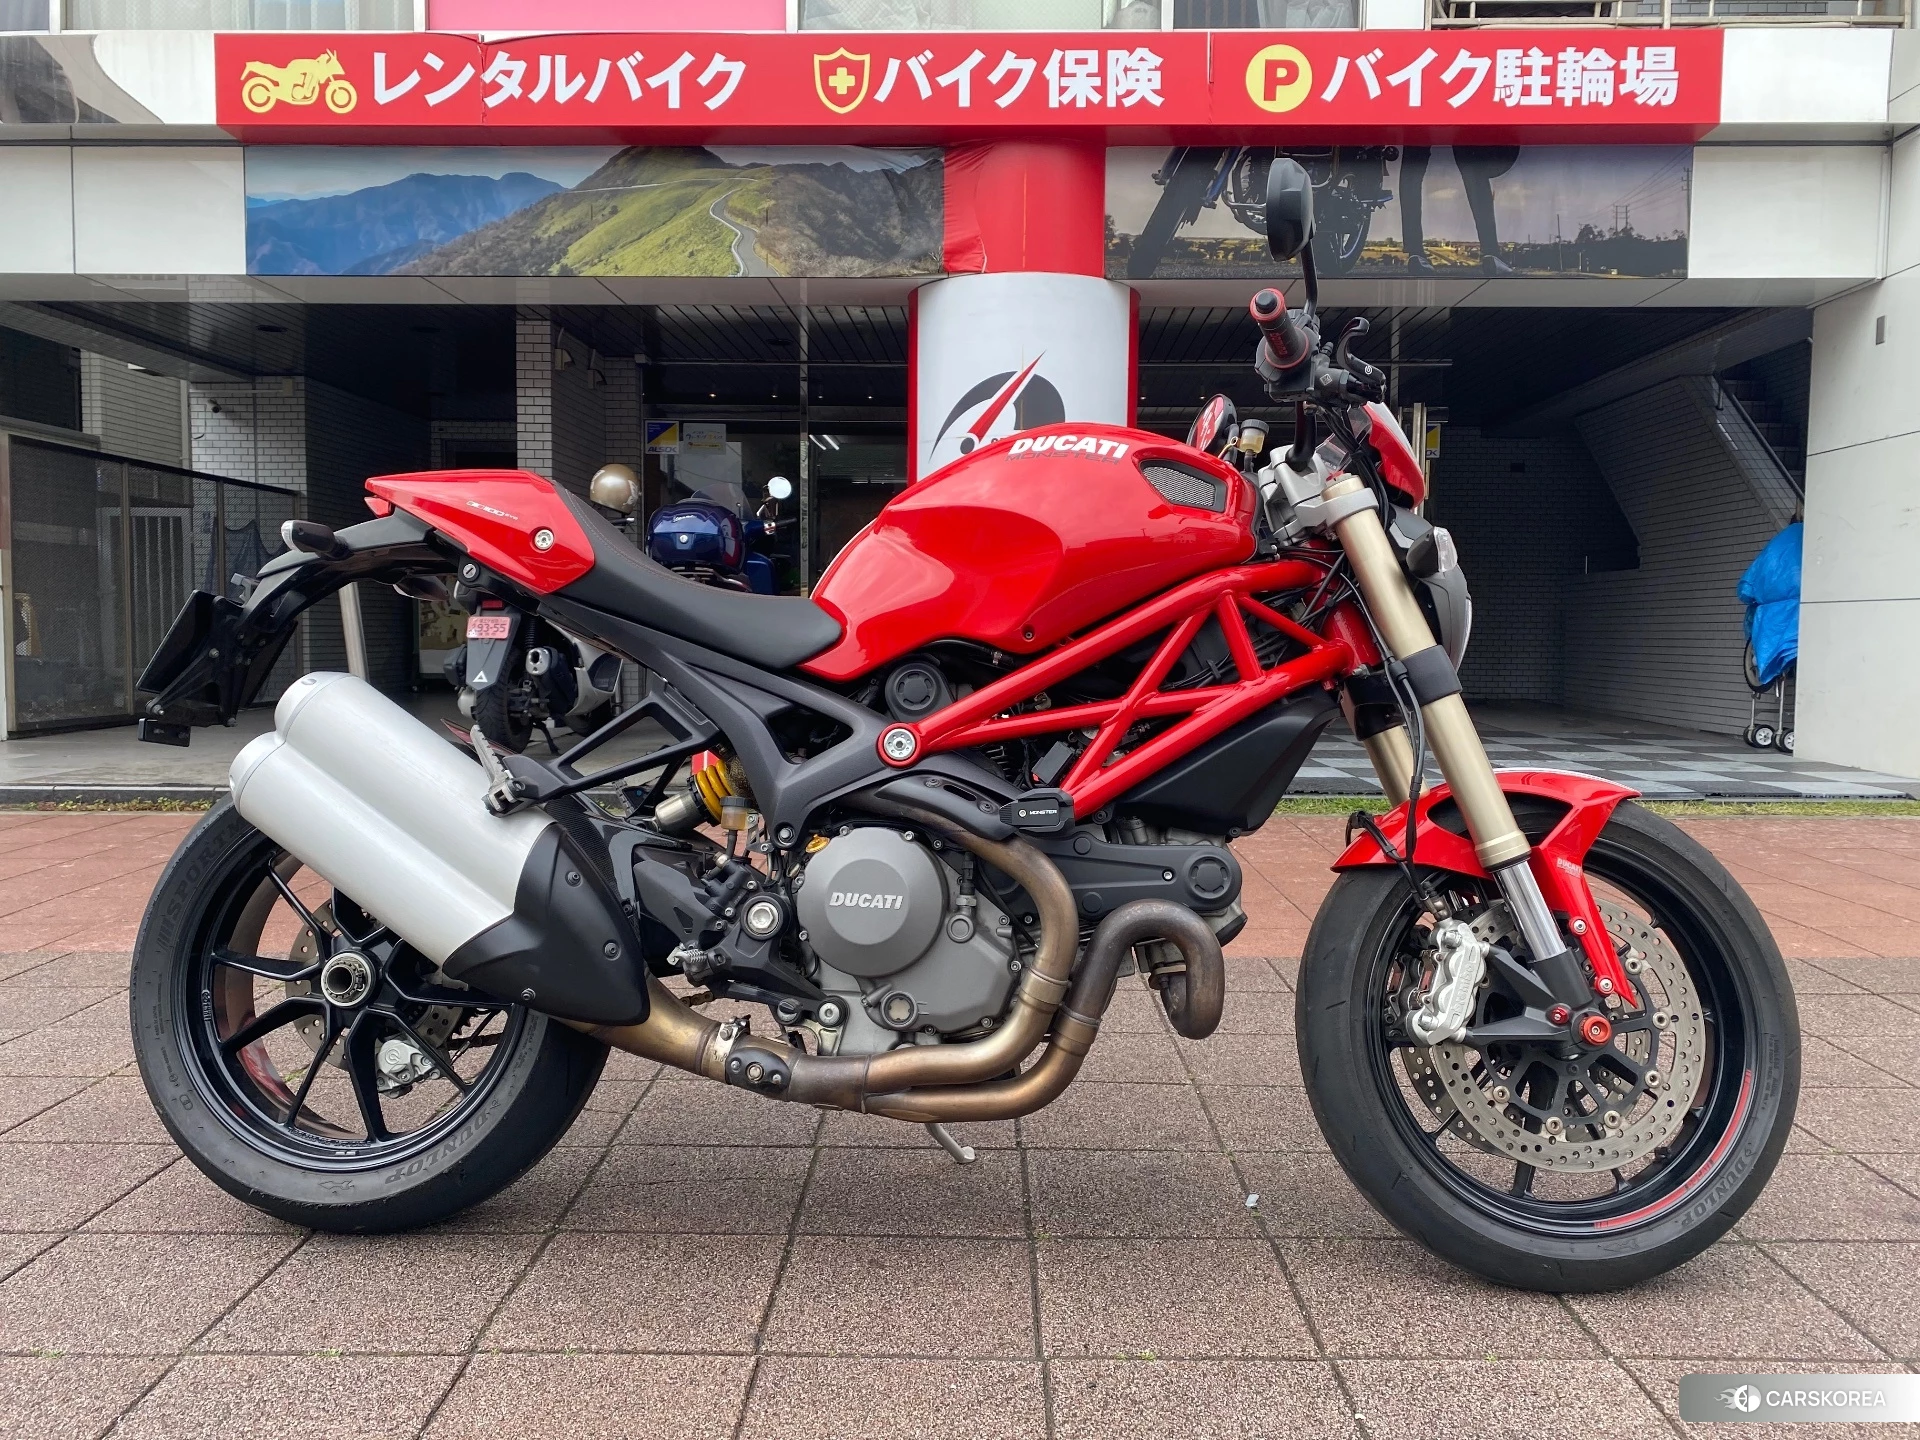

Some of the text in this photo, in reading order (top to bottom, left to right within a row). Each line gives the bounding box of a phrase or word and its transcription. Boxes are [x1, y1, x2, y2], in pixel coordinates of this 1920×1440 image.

[374, 51, 747, 110] レンタルバイク
[873, 48, 1165, 108] バイク保険
[1264, 59, 1300, 101] P
[1320, 47, 1679, 107] バイク駐輪場
[1005, 450, 1120, 465] MONSTER
[1007, 435, 1130, 459] DUCATI
[829, 891, 904, 910] DUCATI
[384, 1111, 489, 1185] DUNLOP
[1681, 1155, 1751, 1230] DUNLOP
